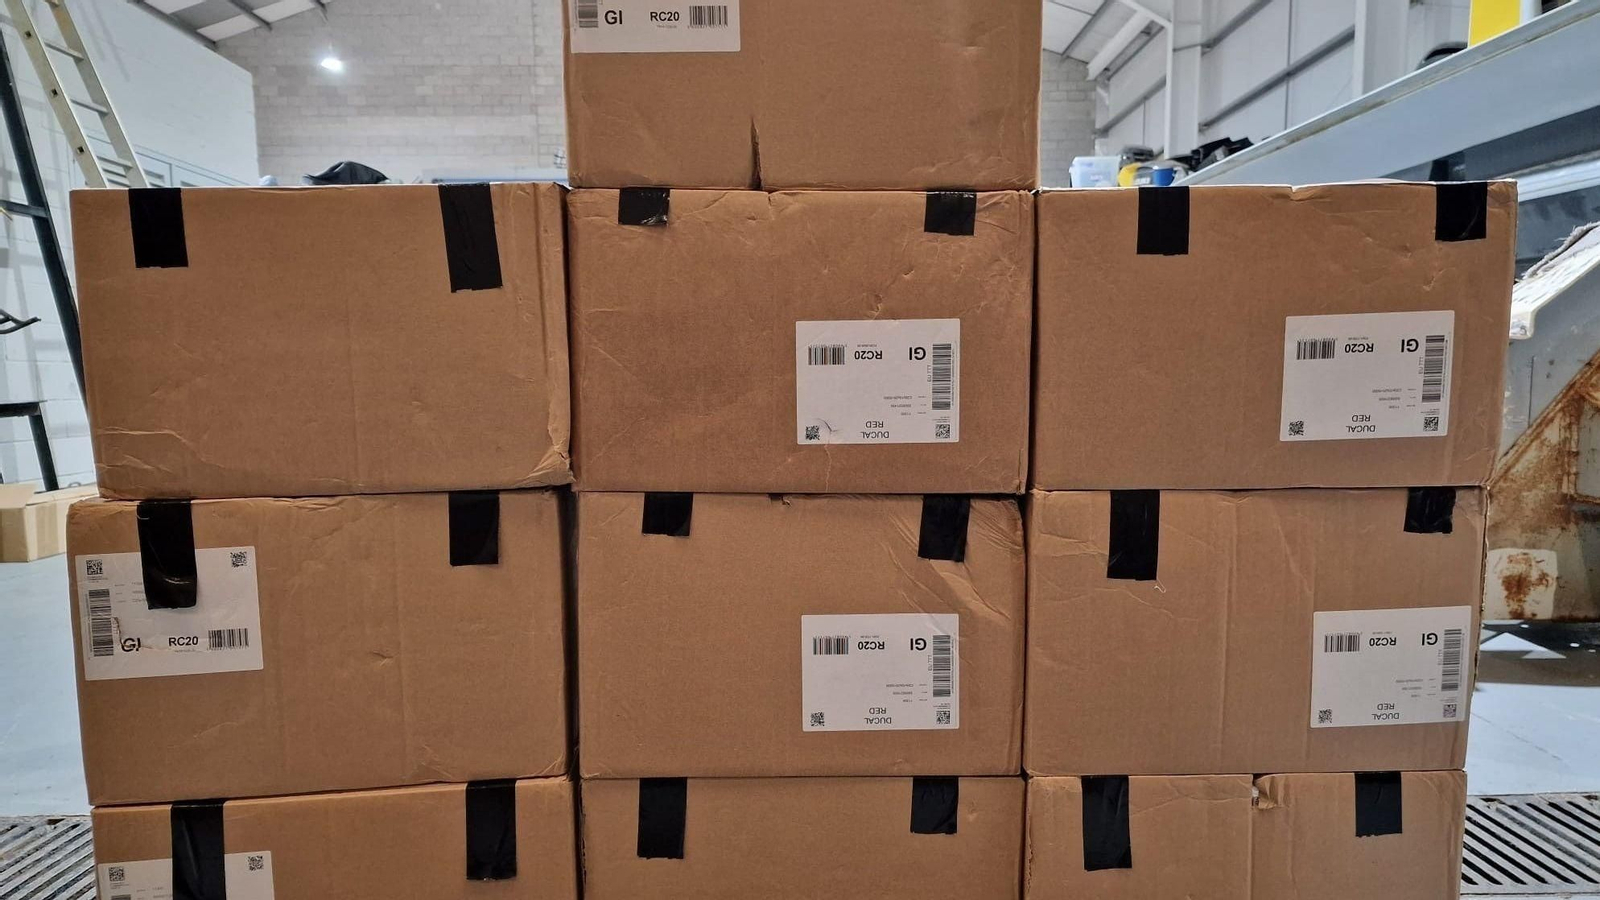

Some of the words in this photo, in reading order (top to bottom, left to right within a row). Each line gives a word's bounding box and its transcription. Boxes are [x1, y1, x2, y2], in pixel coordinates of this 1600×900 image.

[604, 10, 623, 25] GI
[650, 11, 680, 22] RC20
[1344, 343, 1374, 353] RC20
[1401, 339, 1419, 352] GI
[854, 350, 883, 360] RC20
[909, 347, 926, 360] GI
[1352, 414, 1371, 422] RED
[1346, 425, 1376, 433] DUCAL
[860, 431, 890, 439] DUCAL
[168, 636, 199, 647] RC20
[910, 638, 927, 650] GI
[1369, 637, 1397, 646] RC20
[1421, 633, 1438, 646] GI
[857, 641, 885, 650] RC20
[864, 717, 892, 725] DUCAL
[1371, 712, 1400, 720] DUCAL
